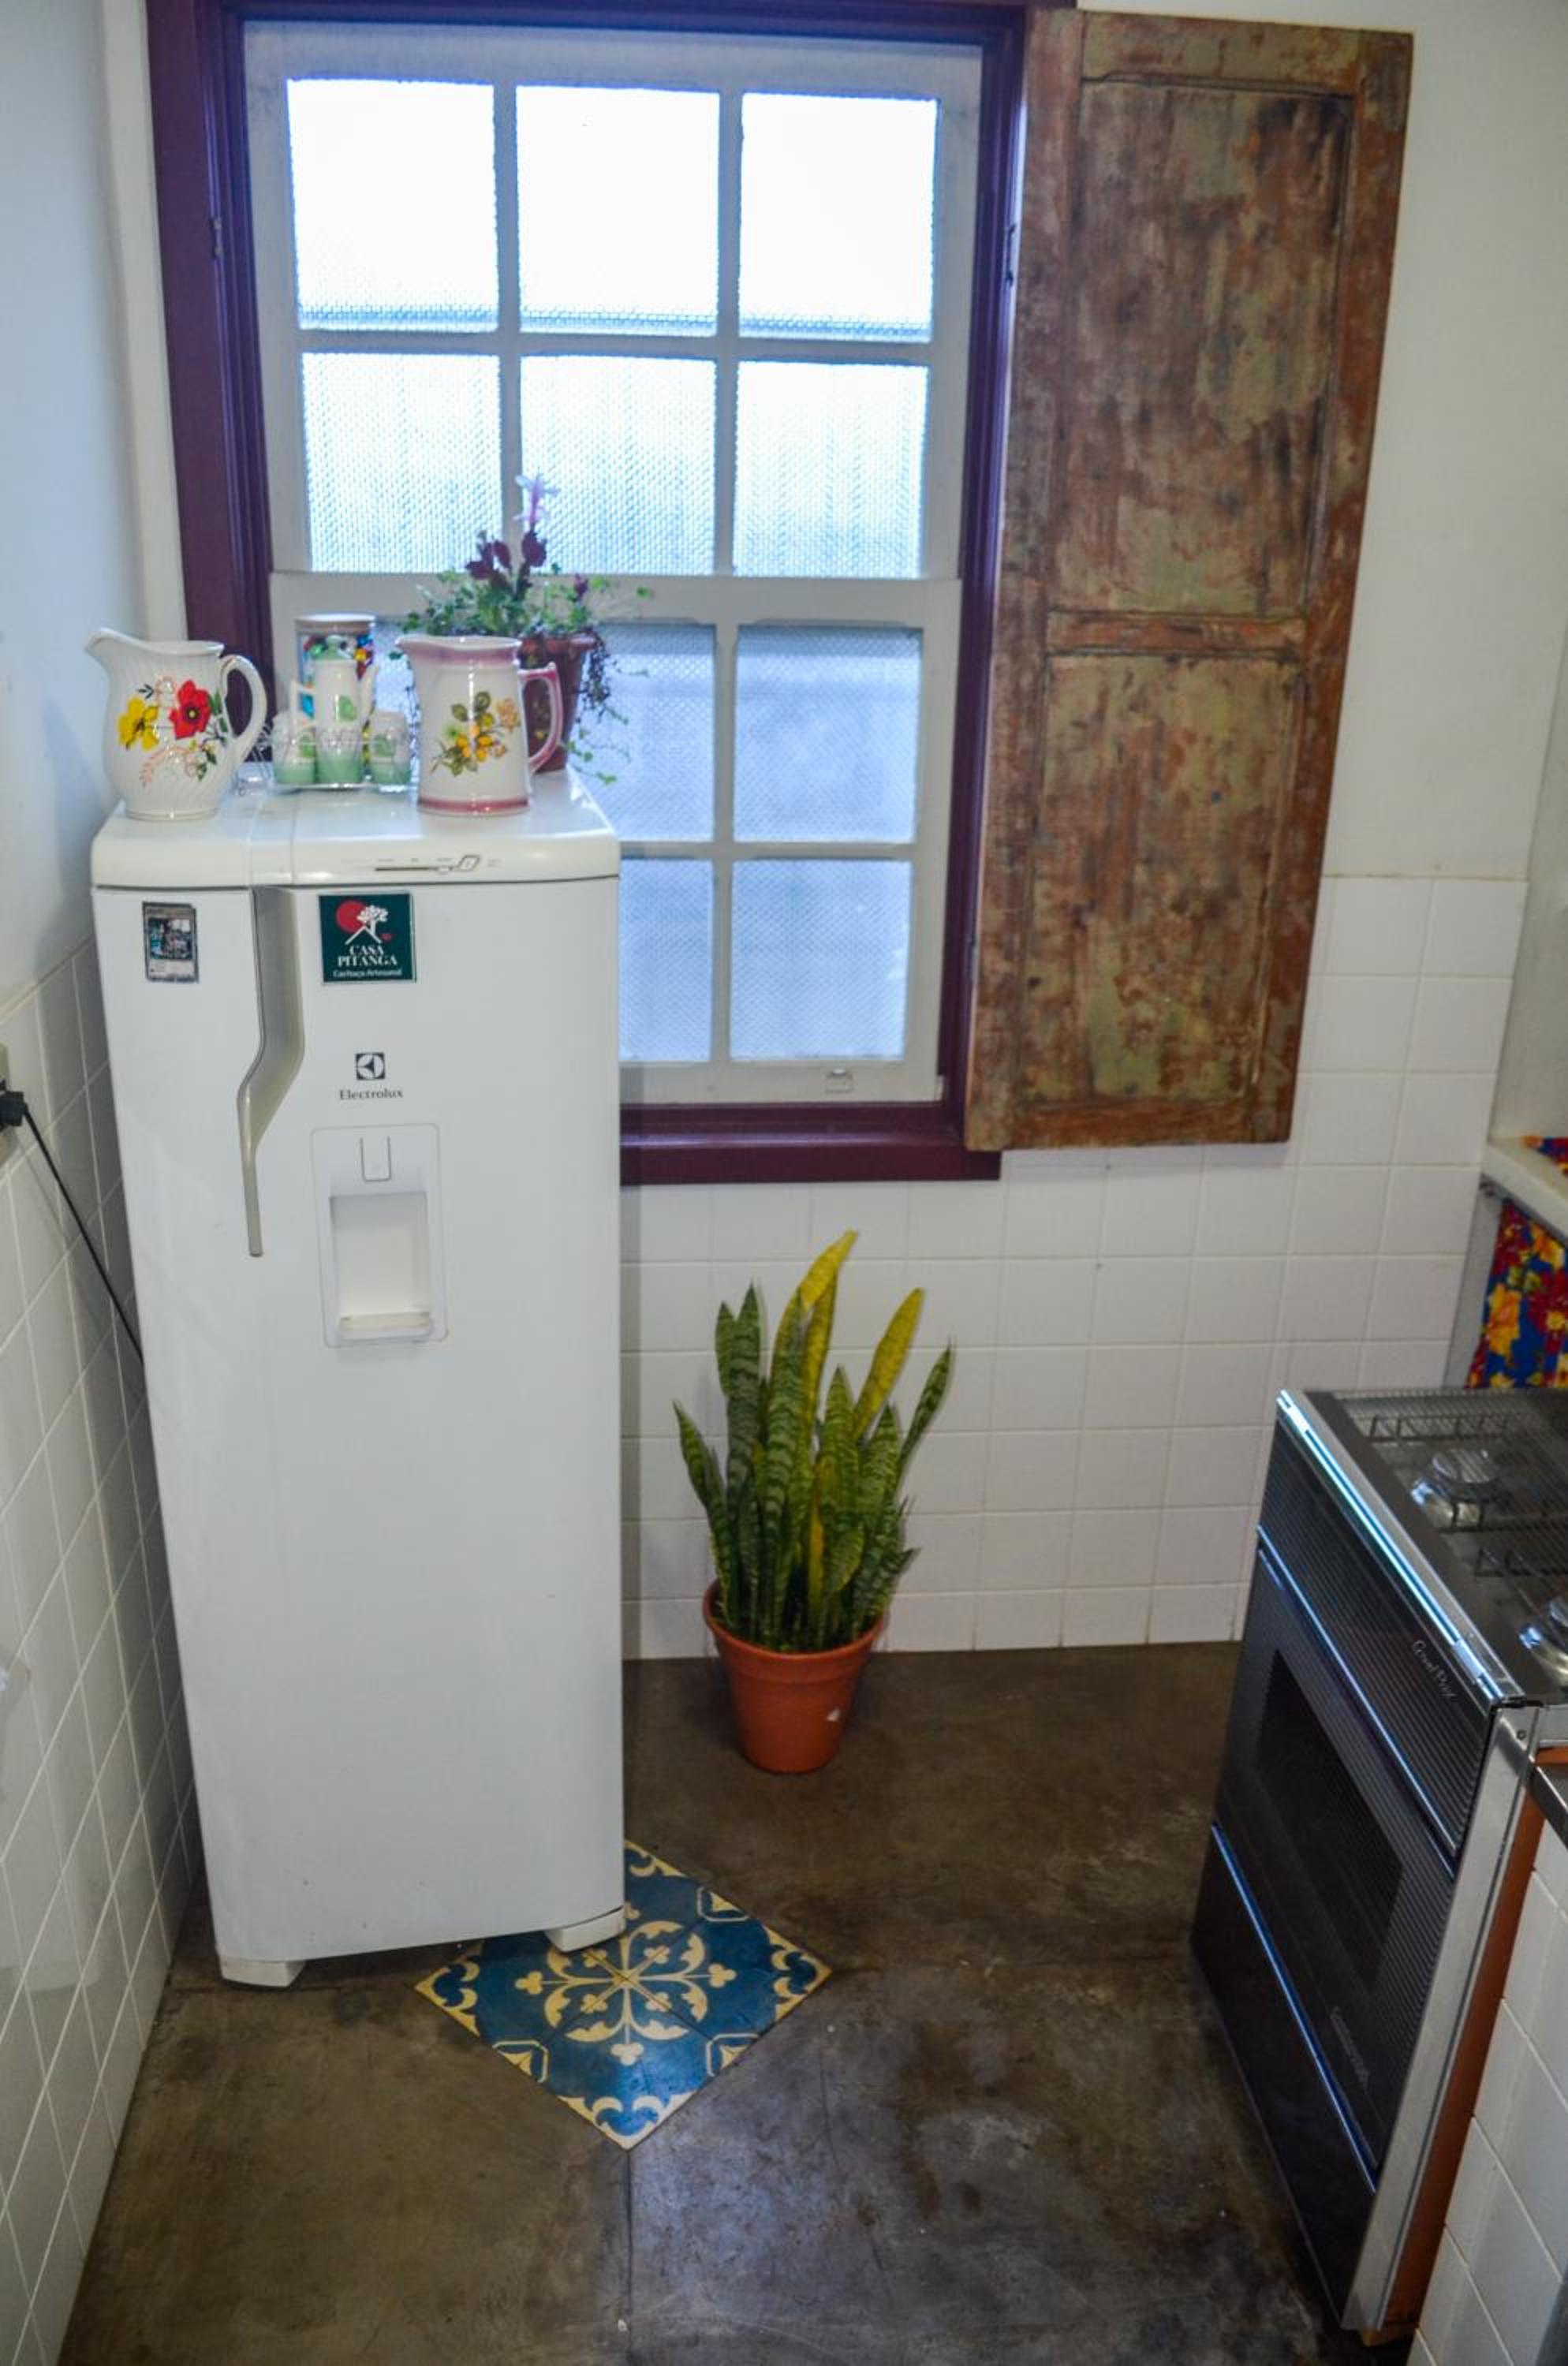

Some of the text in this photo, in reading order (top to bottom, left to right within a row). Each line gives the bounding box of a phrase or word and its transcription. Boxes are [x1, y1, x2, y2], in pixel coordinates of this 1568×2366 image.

[349, 945, 385, 956] CASA
[338, 953, 398, 967] PITANGA
[339, 1088, 404, 1100] Electrolux
